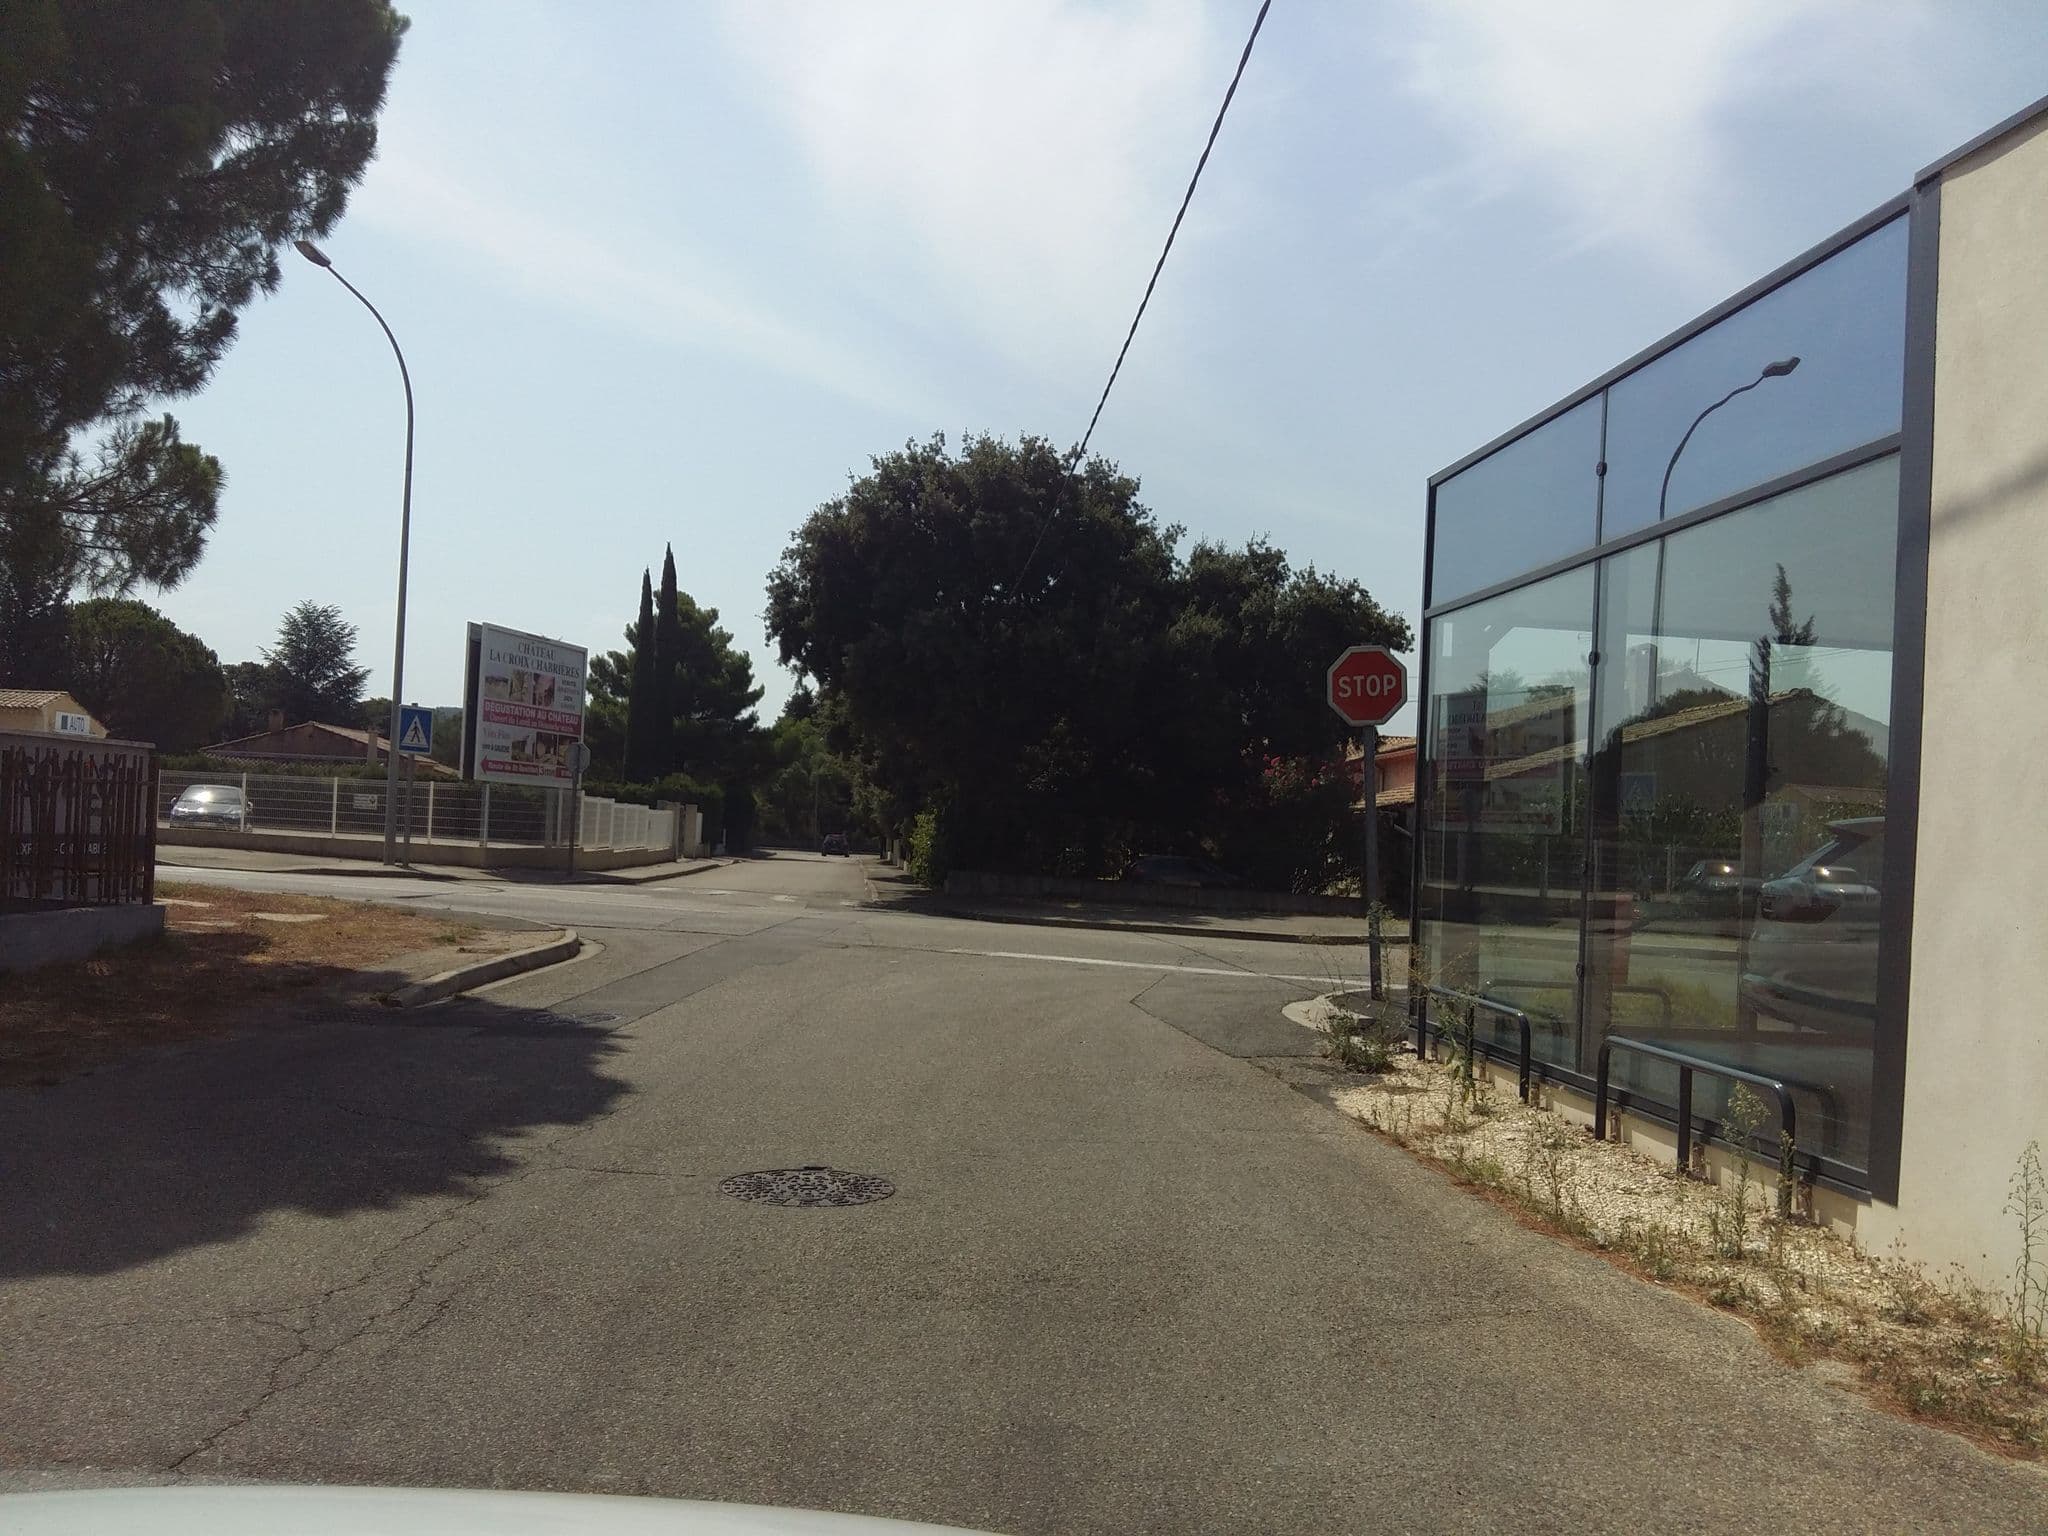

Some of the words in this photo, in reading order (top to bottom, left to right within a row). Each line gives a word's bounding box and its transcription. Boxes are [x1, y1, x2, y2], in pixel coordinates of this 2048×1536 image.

[489, 648, 501, 663] LA
[503, 653, 529, 669] CROIX
[1338, 674, 1397, 698] STOP
[537, 709, 548, 720] AU
